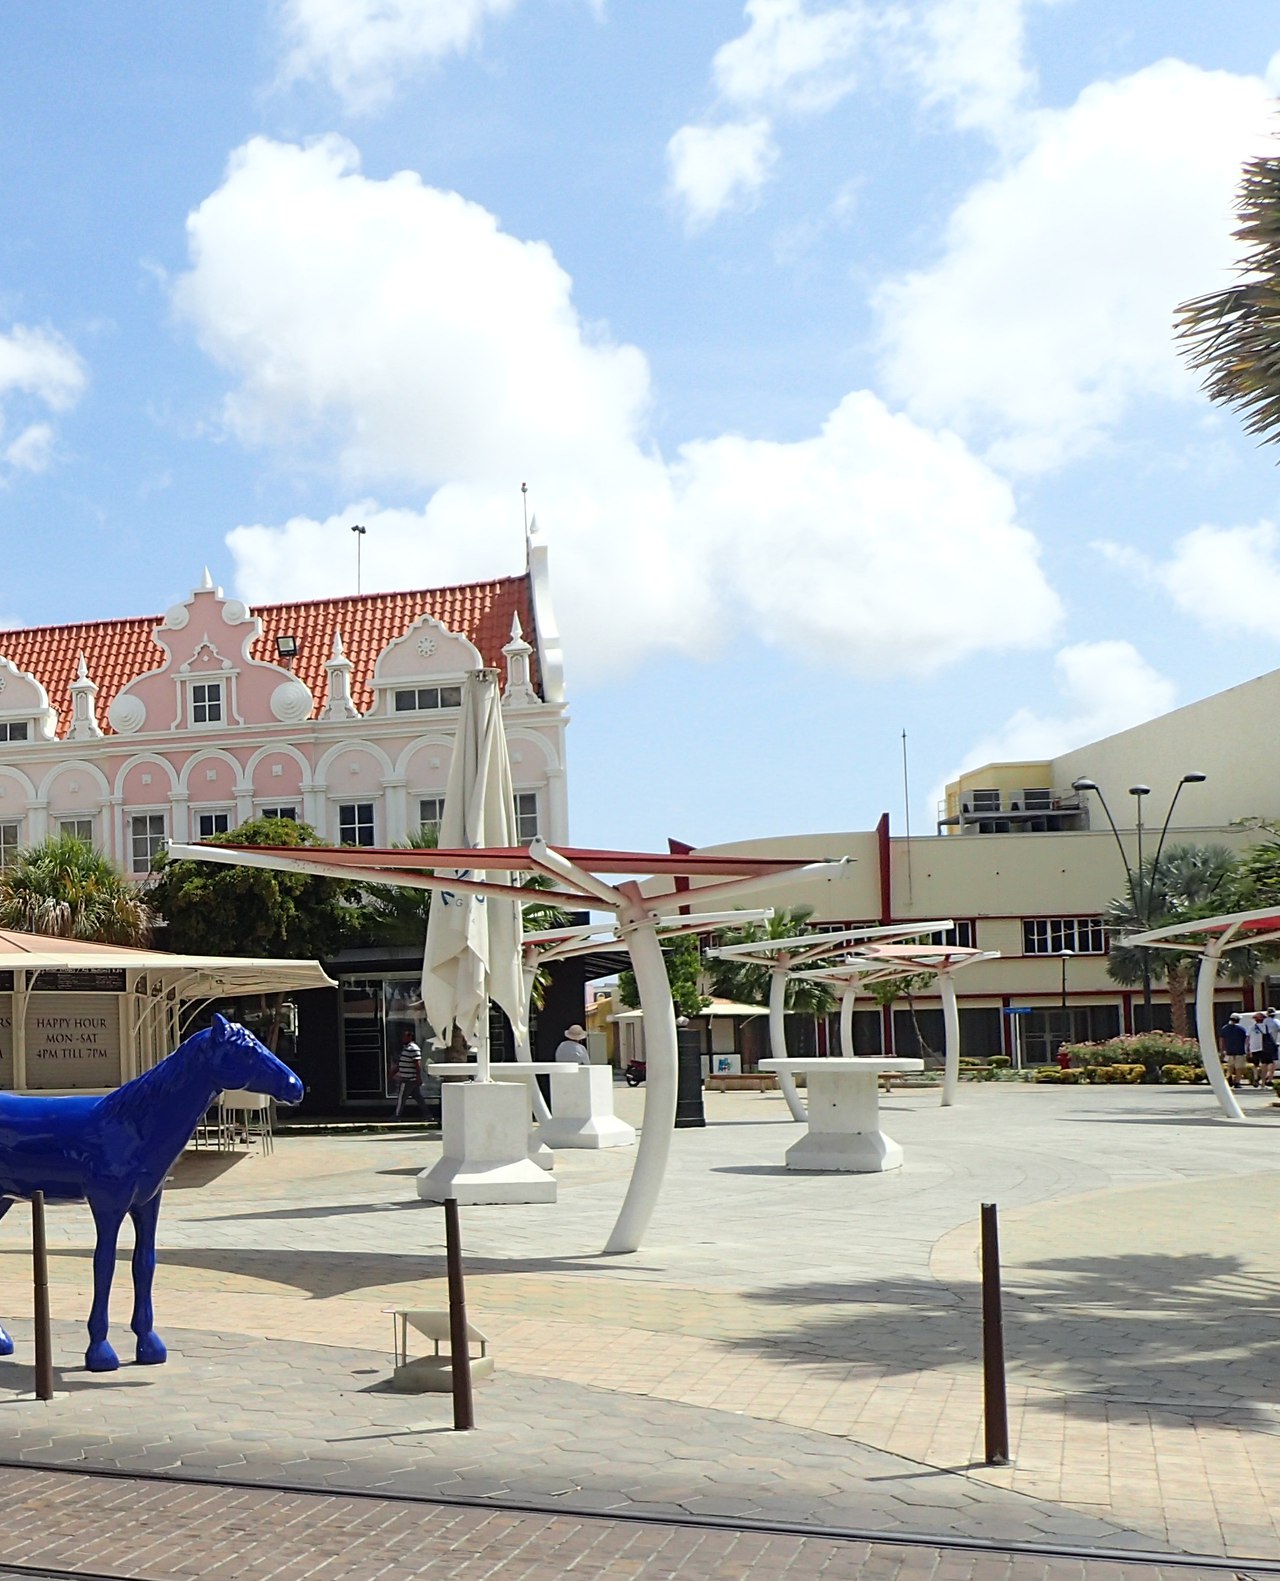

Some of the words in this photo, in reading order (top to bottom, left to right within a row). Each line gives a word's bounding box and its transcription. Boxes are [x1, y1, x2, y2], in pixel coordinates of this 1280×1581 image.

[36, 1018, 70, 1028] HAPPY
[74, 1018, 107, 1028] HOUR
[46, 1033, 73, 1043] MON
[37, 1048, 58, 1059] 4PM
[62, 1049, 83, 1058] TILL
[86, 1048, 108, 1058] 7PM
